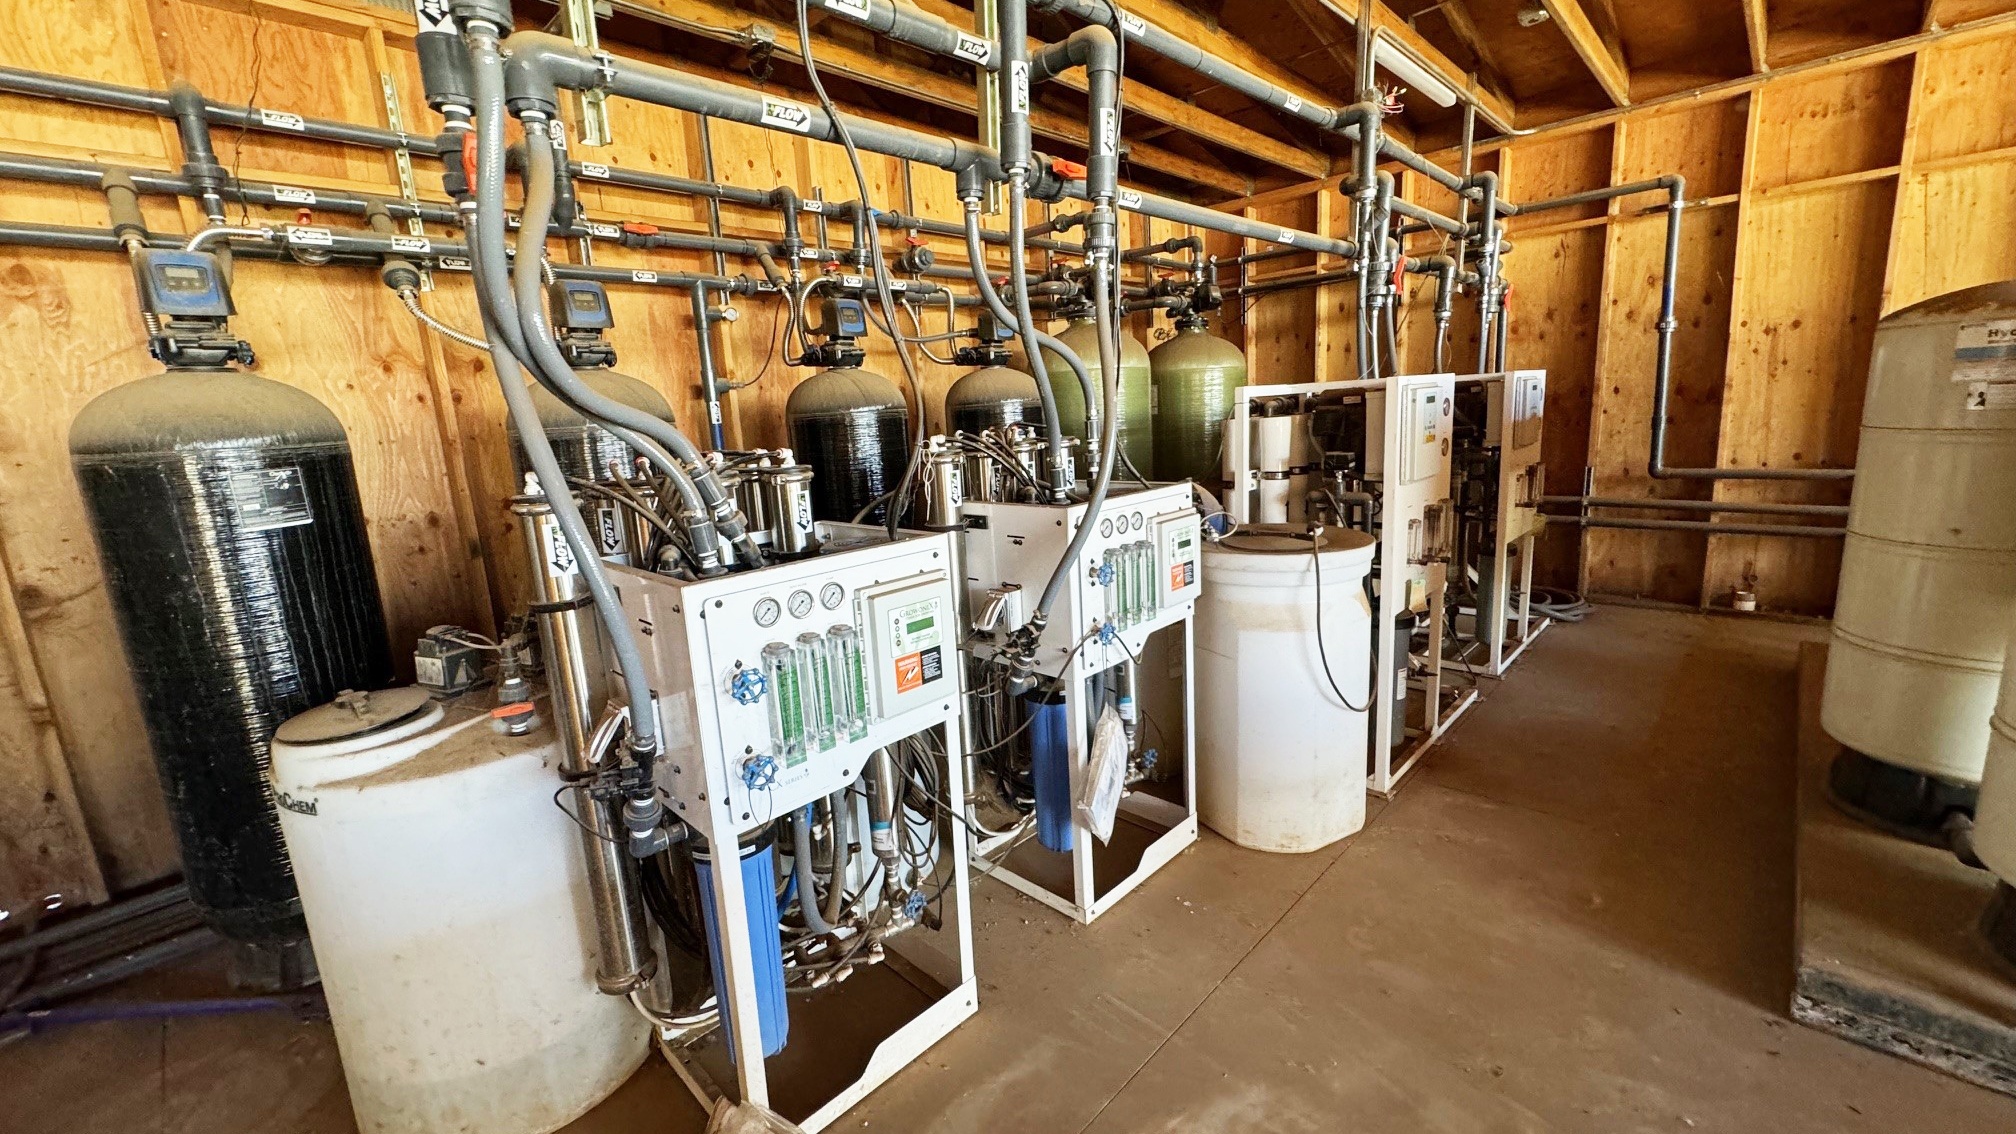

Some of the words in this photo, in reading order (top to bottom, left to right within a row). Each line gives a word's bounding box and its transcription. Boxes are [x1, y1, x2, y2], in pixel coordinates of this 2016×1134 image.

[962, 42, 986, 57] FLOW
[1018, 70, 1028, 103] FLOW
[271, 113, 298, 124] FLOW
[773, 105, 804, 121] FLOW
[1107, 117, 1115, 146] FLOW
[283, 189, 307, 199] FLOW
[401, 239, 424, 247] FLOW
[951, 476, 960, 499] FLOW
[799, 500, 809, 525] FLOW
[604, 517, 616, 546] FLOW
[554, 533, 570, 568] FLOW
